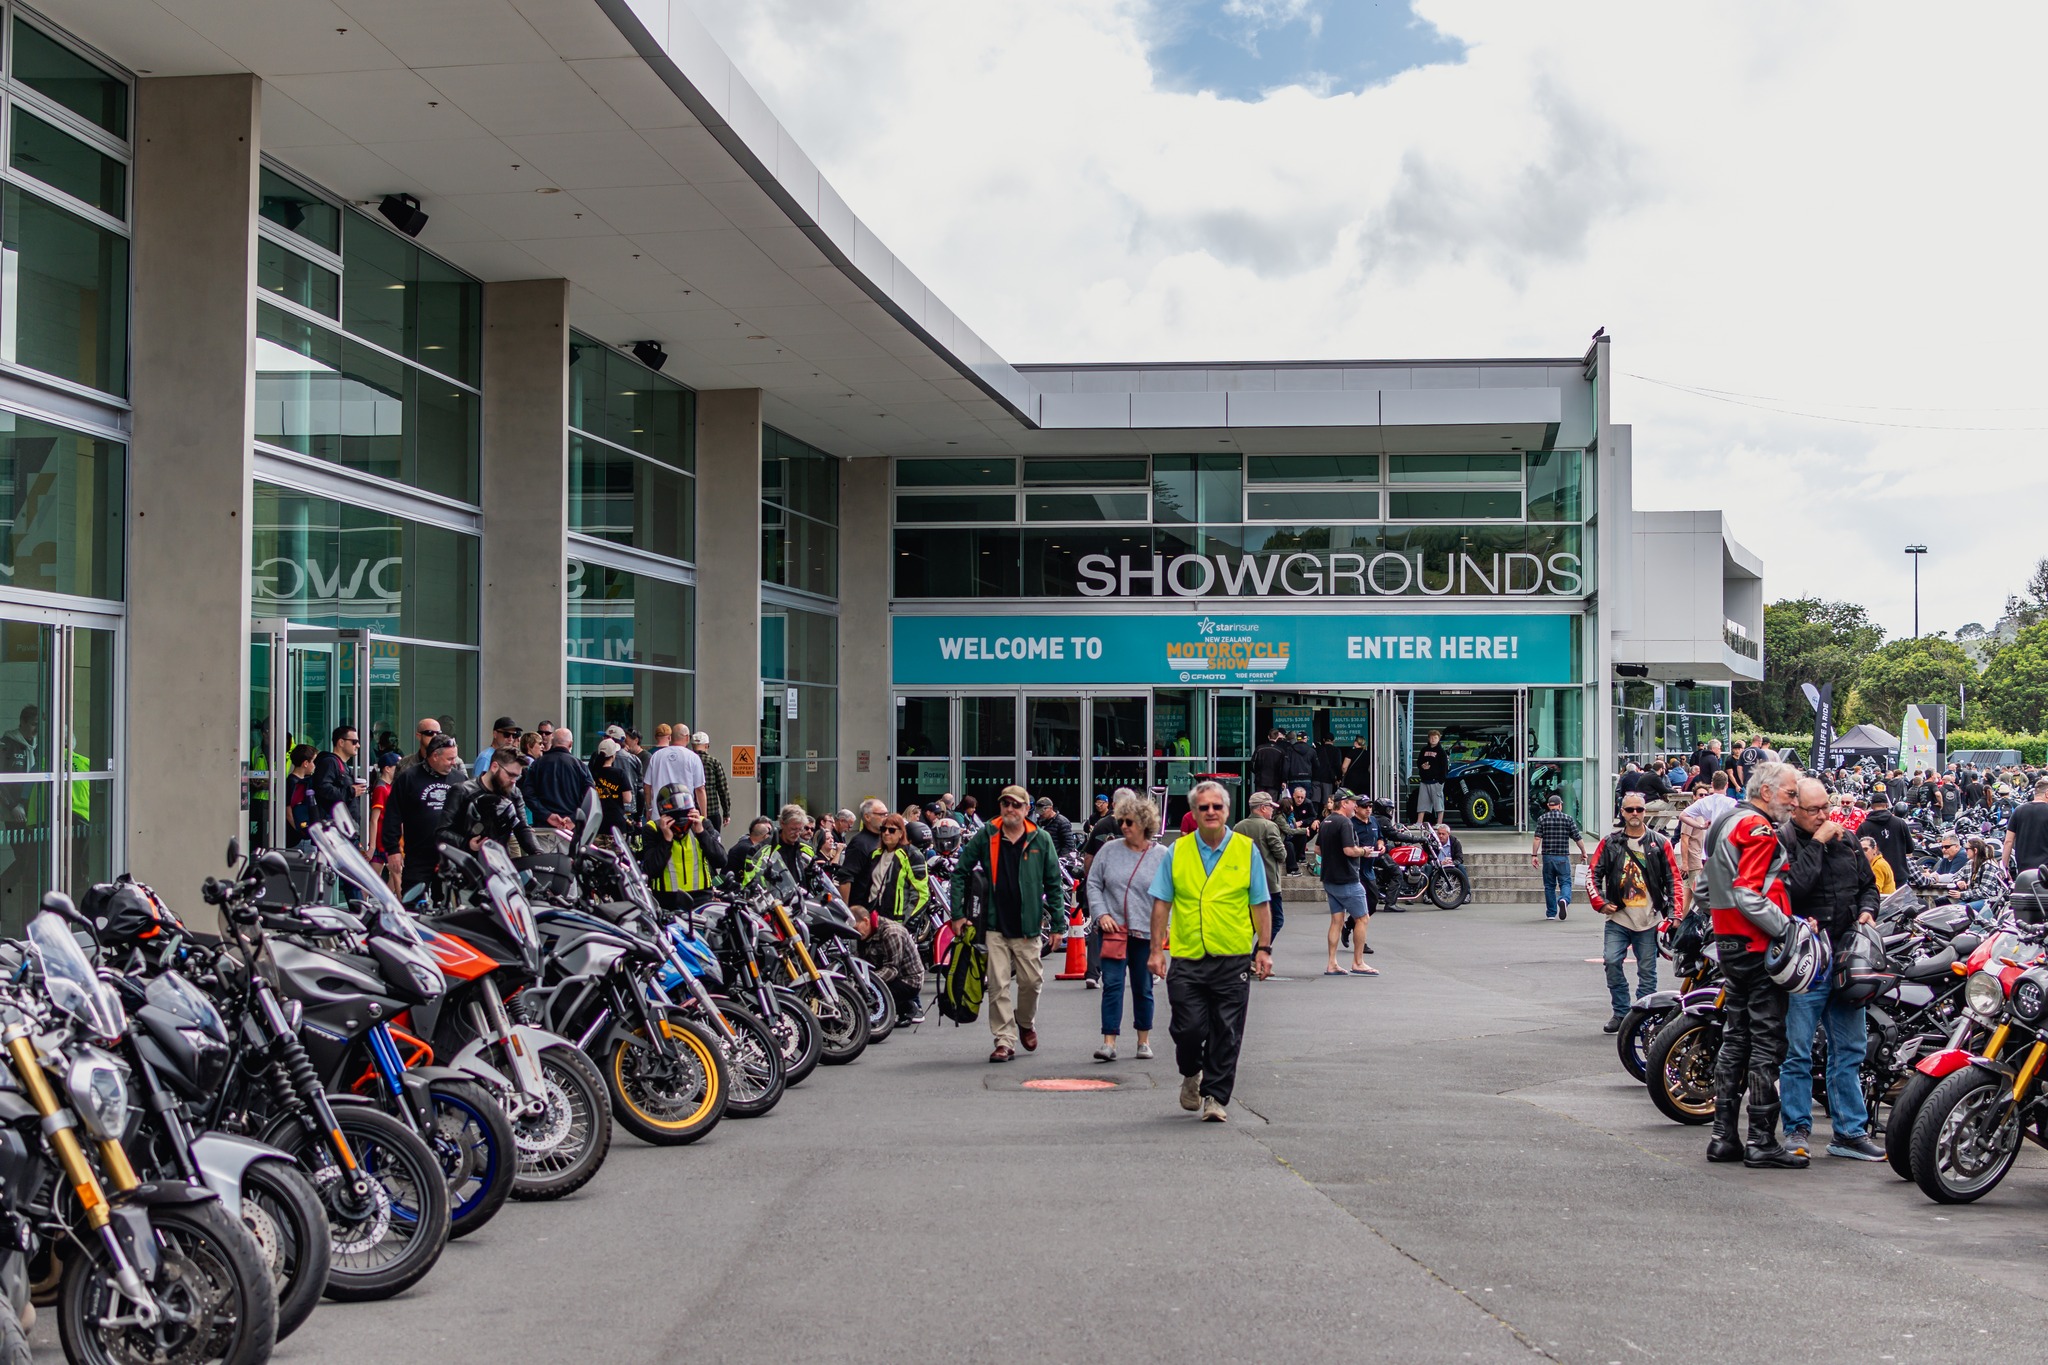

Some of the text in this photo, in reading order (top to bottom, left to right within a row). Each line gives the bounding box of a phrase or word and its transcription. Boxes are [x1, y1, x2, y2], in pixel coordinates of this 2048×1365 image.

[1076, 553, 1582, 597] SHOWGROUNDS
[1215, 622, 1260, 632] starinsure
[939, 636, 1103, 660] WELCOME TO
[1166, 642, 1290, 658] MOTORCYCLE
[1347, 635, 1519, 659] ENTER HERE!
[1207, 657, 1250, 670] SHOW
[1274, 709, 1311, 717] TICKETS
[1331, 709, 1367, 717] TICKETS
[1819, 729, 1828, 746] LIFE
[1817, 747, 1826, 771] MAKE
[923, 771, 945, 779] Rotary
